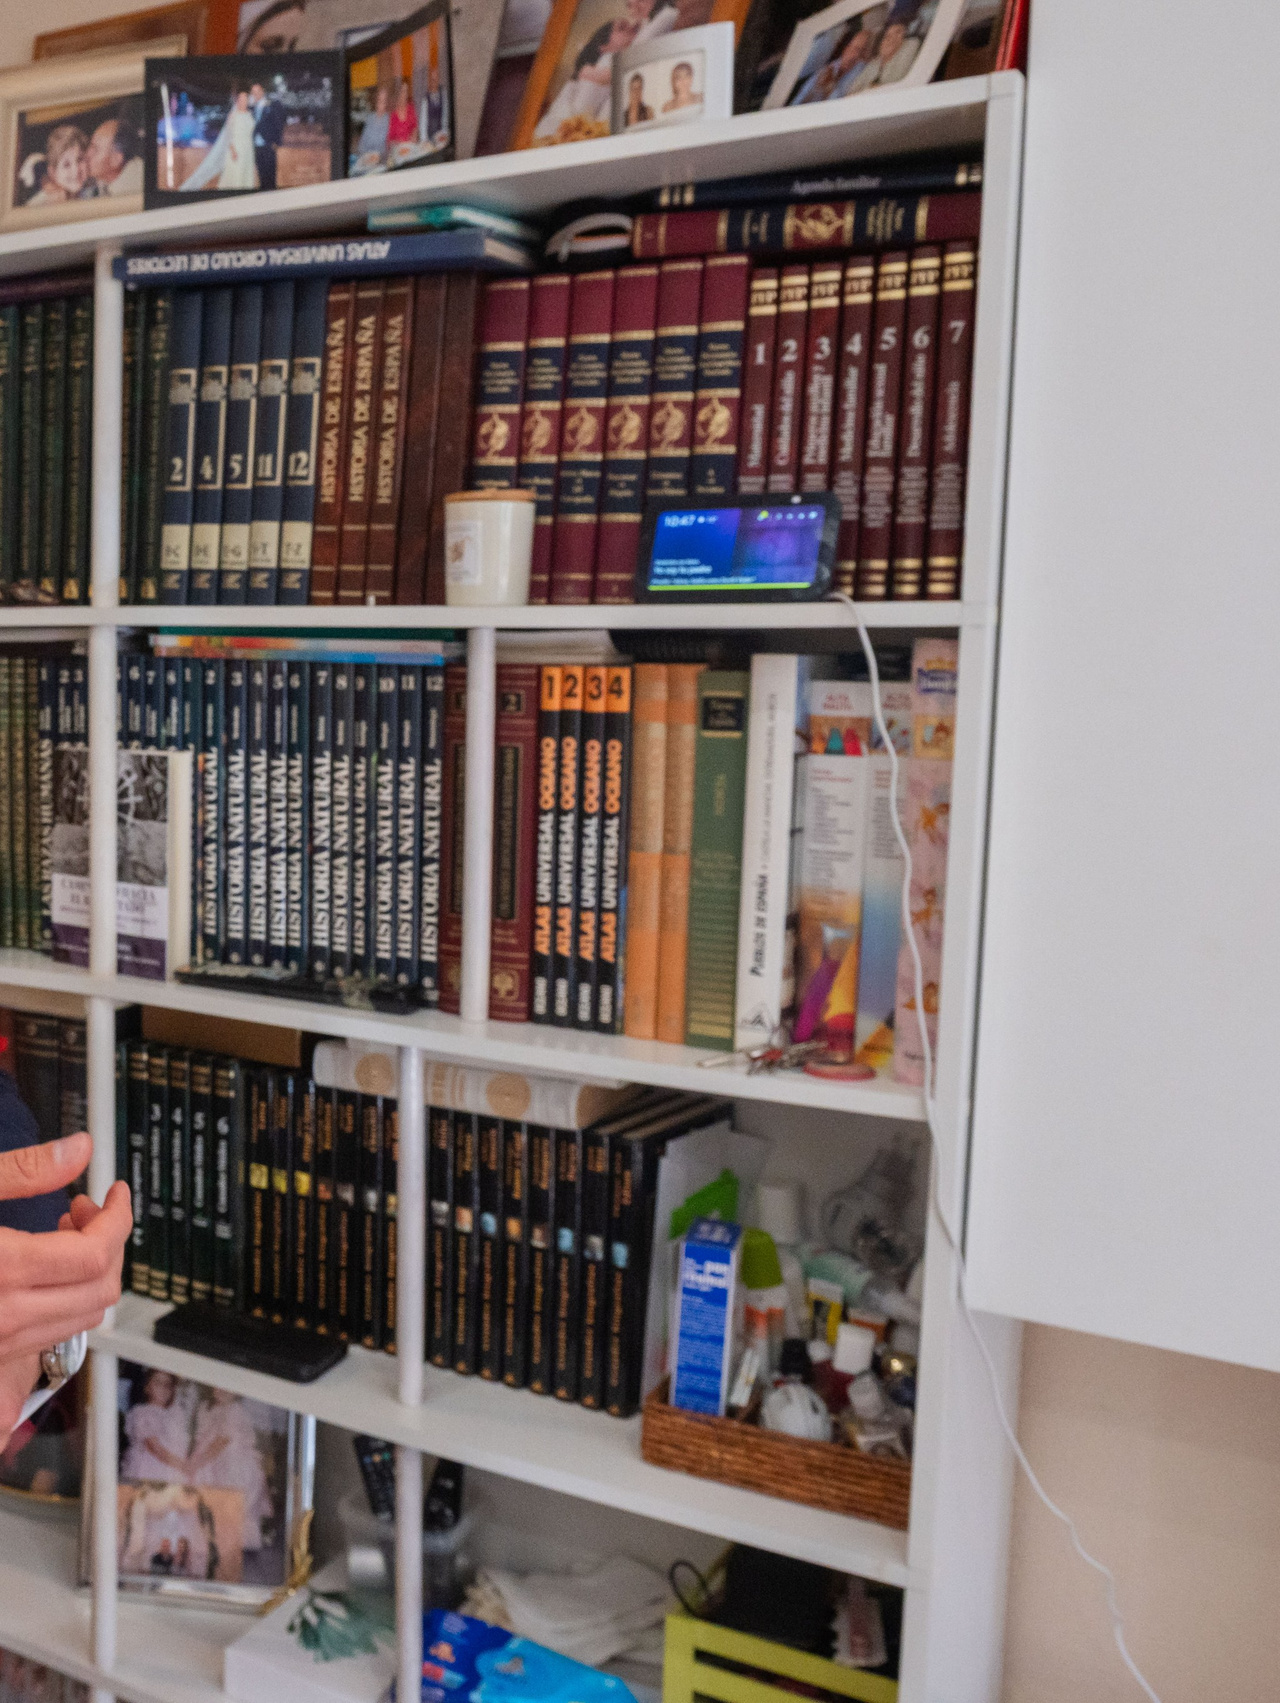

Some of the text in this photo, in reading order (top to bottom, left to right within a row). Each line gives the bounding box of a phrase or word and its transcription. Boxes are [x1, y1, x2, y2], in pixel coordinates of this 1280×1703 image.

[270, 243, 345, 266] UNIVERSAL
[346, 241, 391, 262] ATLAS
[127, 254, 188, 275] LECTORES
[880, 327, 897, 350] 5
[912, 326, 930, 349] 6
[949, 320, 966, 344] 7
[756, 343, 766, 365] 1
[781, 339, 798, 362] 2
[815, 336, 831, 360] 3
[846, 333, 862, 355] 4
[320, 317, 347, 503] HISTORIA DE ESPAÑA
[348, 315, 376, 502] HISTORIA DE ESPAÑA
[376, 314, 404, 504] HISTORIA DE ESPAÑA
[171, 456, 184, 482] 2
[200, 455, 214, 481] 4
[229, 453, 243, 479] 5
[257, 452, 273, 478] 11
[288, 451, 309, 477] 12
[130, 666, 140, 680] 6
[147, 671, 155, 684] 7
[186, 668, 190, 682] 1
[206, 670, 215, 684] 2
[231, 672, 242, 686] 3
[254, 672, 262, 685] 4
[273, 674, 283, 689] 5
[290, 674, 299, 688] 6
[318, 671, 328, 685] 7
[336, 675, 347, 690] 8
[380, 677, 394, 692] 10
[402, 675, 414, 690] 11
[427, 676, 443, 690] 12
[546, 675, 555, 698] 1
[564, 674, 578, 698] 2
[589, 675, 603, 698] 3
[608, 674, 624, 698] 4
[205, 747, 217, 934] HISTORIA NATURAL
[228, 750, 244, 939] HISTORIA NATURAL
[250, 750, 266, 940] HISTORIA NATURAL
[270, 754, 286, 946] HISTORIA NATURAL
[289, 753, 302, 946] HISTORIA NATURAL
[313, 751, 330, 947] HISTORIA NATURAL
[534, 735, 557, 957] ATLAS UNIVERSAL OCEANO
[555, 735, 577, 958] ATLAS UNIVERSAL OCEANO
[578, 739, 601, 962] ATLAS UNIVERSAL OCEANO
[599, 739, 622, 964] ATLAS UNIVERSAL OCEANO
[333, 755, 349, 953] HISTORIA NATURAL
[354, 757, 366, 955] HISTORIA NATURAL
[376, 760, 392, 959] HISTORIA NATURAL
[397, 757, 415, 959] HISTORIA NATURAL
[421, 759, 441, 961] HISTORIA NATURAL
[150, 1103, 162, 1122] 3
[172, 1107, 184, 1125] 4
[194, 1111, 206, 1130] 5
[217, 1115, 230, 1136] 6
